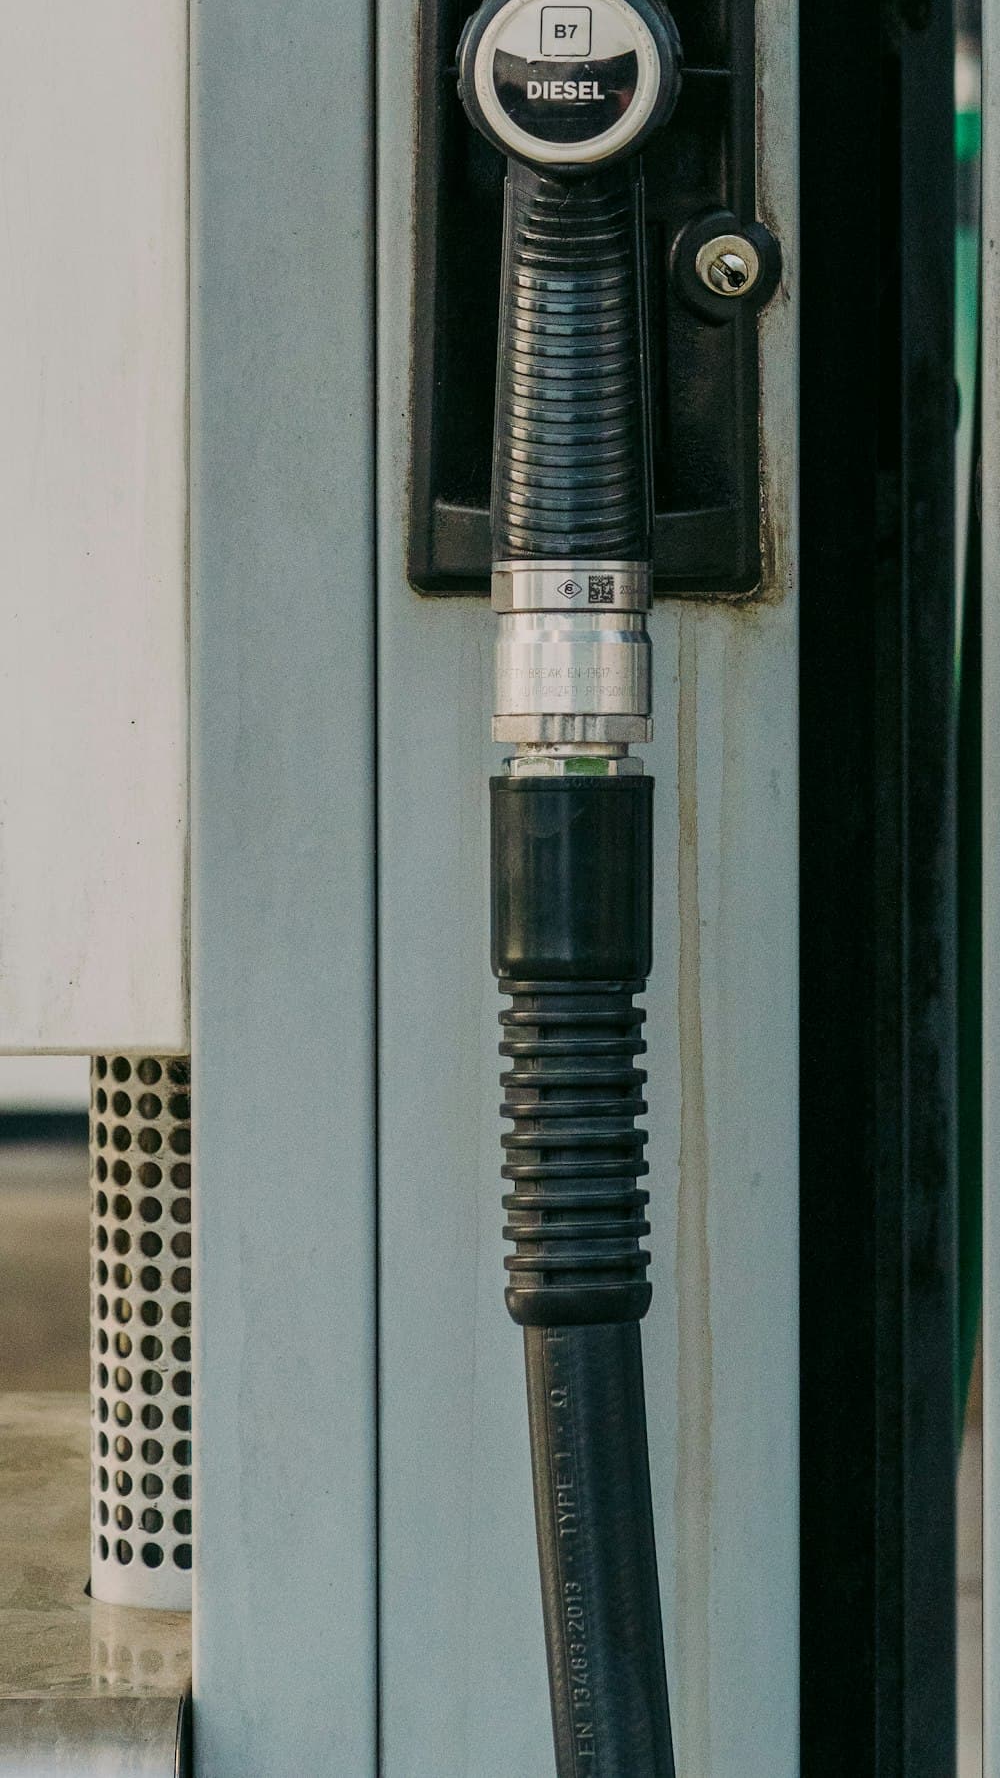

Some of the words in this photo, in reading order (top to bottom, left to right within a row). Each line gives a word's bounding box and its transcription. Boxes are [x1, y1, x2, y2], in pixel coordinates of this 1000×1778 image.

[554, 24, 579, 39] B7
[526, 80, 605, 100] DIESEL
[555, 1469, 577, 1538] TYPE
[575, 1721, 596, 1757] EN
